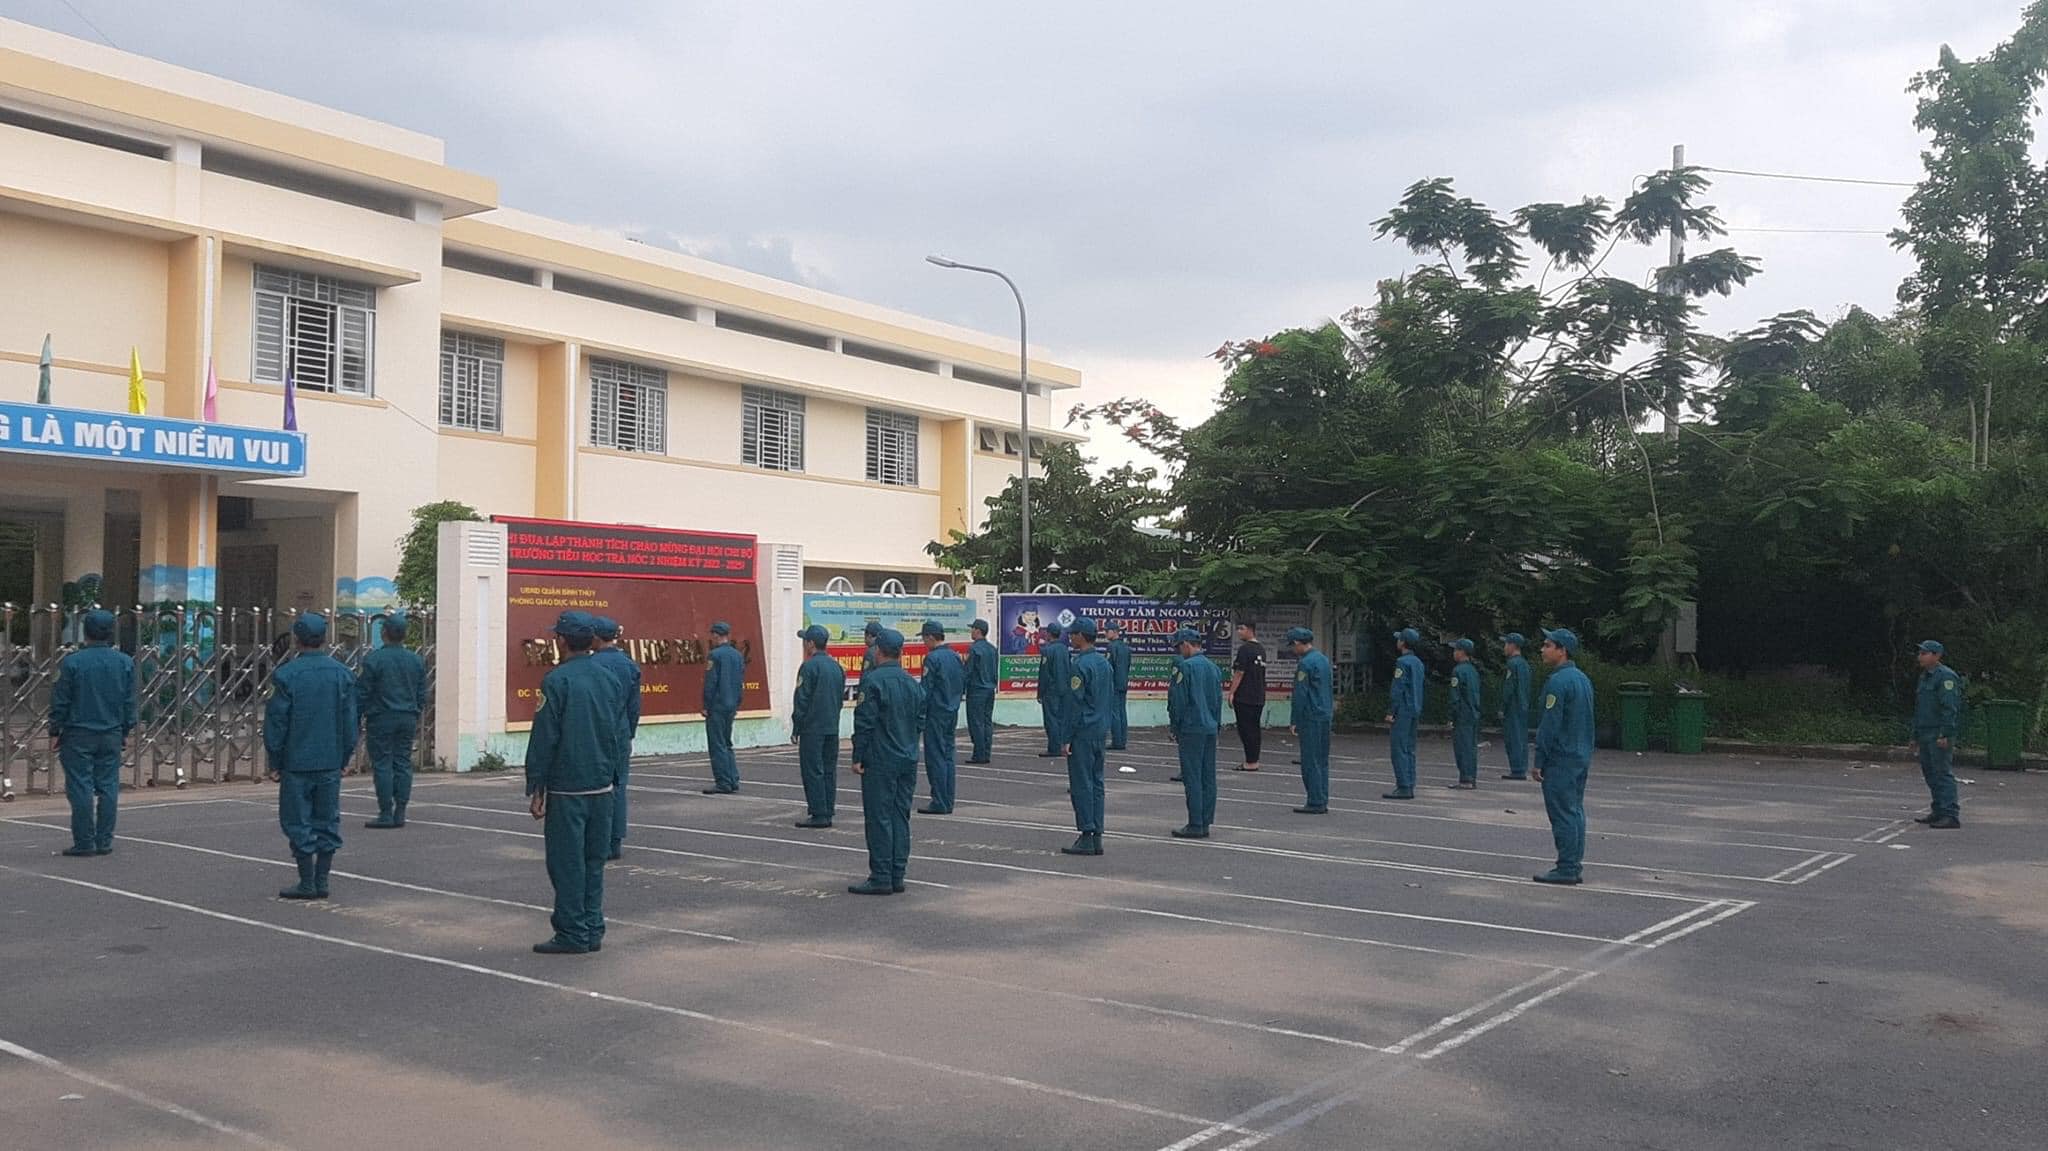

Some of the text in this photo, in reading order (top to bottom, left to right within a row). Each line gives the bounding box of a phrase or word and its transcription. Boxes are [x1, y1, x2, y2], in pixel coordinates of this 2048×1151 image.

[22, 414, 63, 445] LÀ
[74, 420, 145, 456] MỘT
[154, 426, 235, 461] NIỀM
[243, 439, 290, 465] VUI
[1080, 607, 1125, 618] TRUNG
